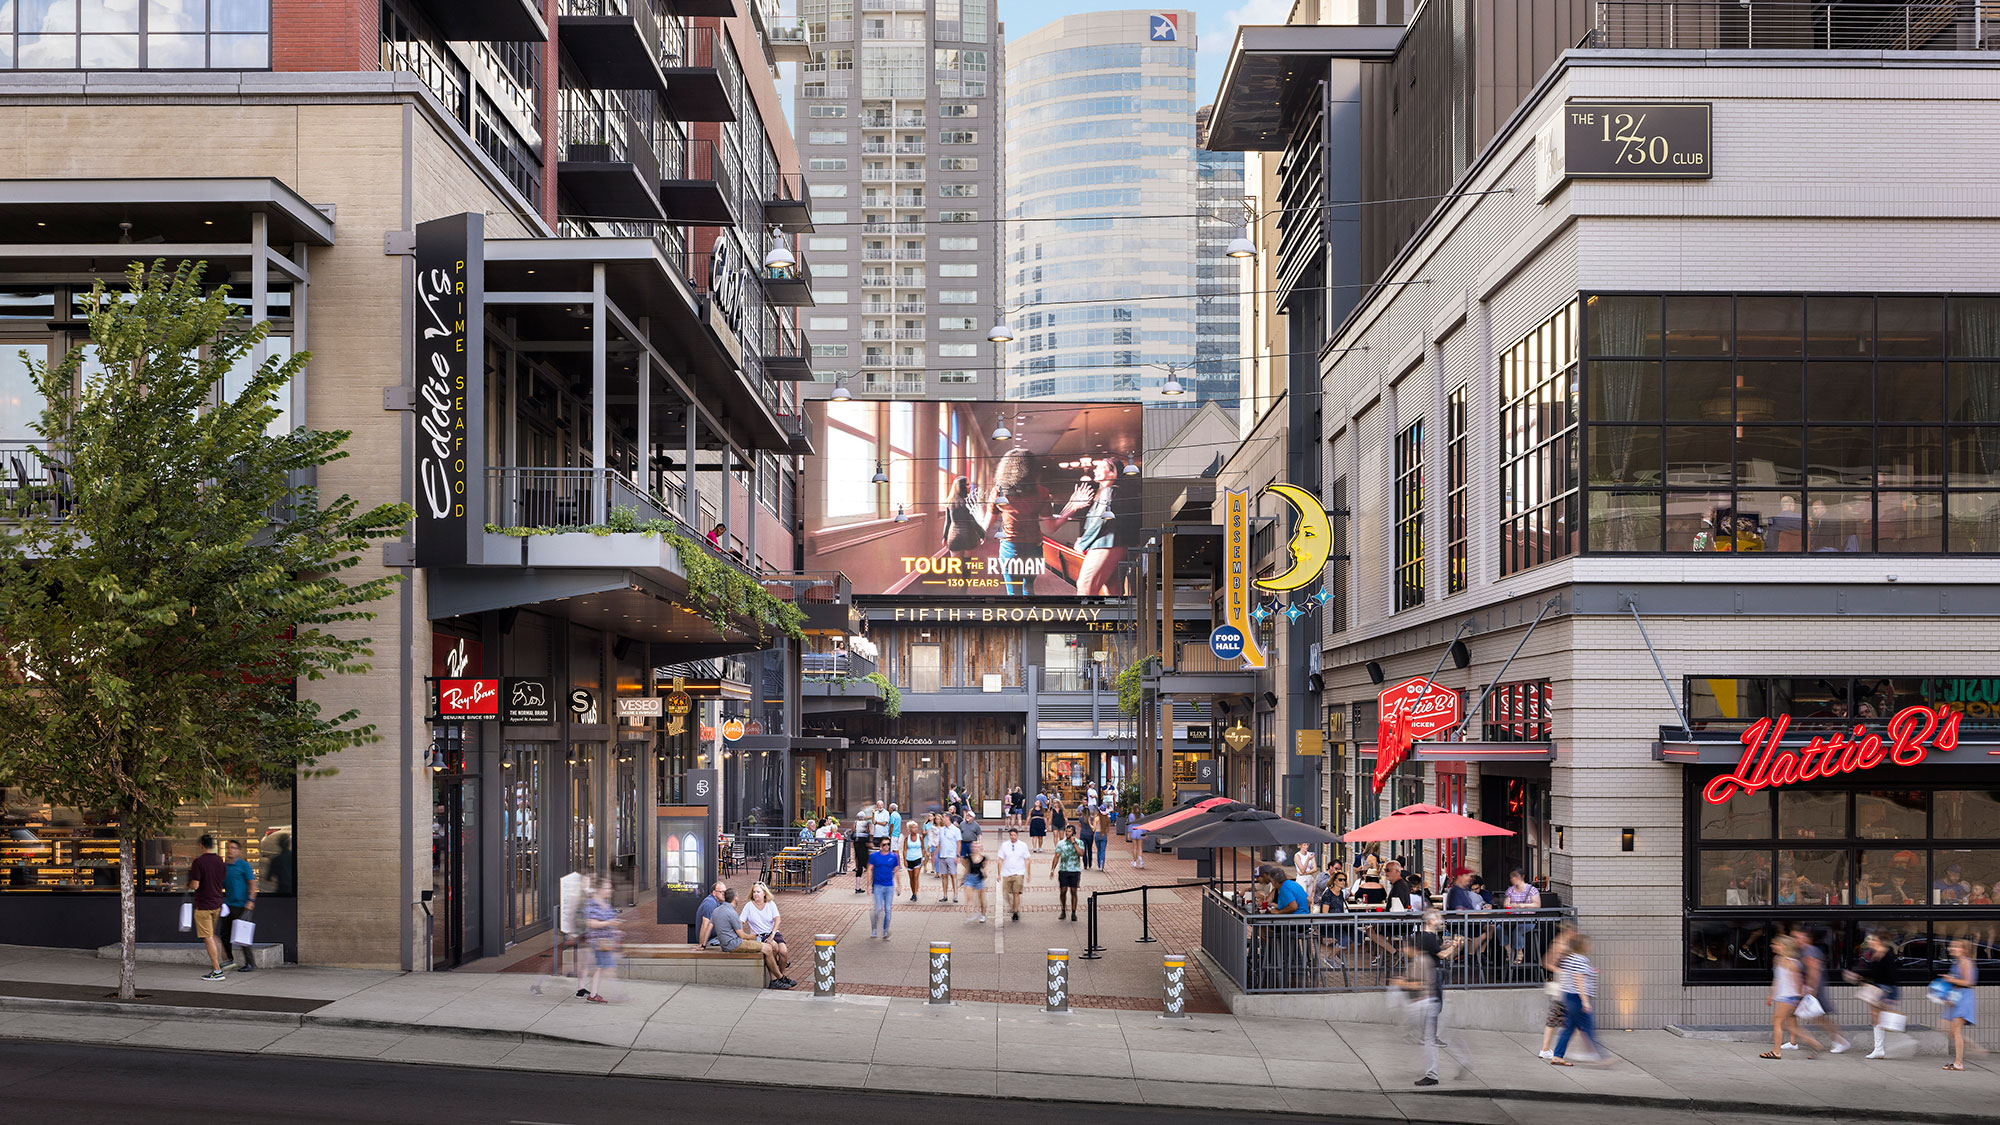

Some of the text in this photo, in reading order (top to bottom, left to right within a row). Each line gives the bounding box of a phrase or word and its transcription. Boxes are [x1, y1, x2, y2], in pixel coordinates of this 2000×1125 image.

[1571, 113, 1594, 125] THE
[1672, 152, 1703, 165] CLUB
[455, 260, 464, 353] PRIME
[418, 269, 451, 519] Eddie V's
[455, 376, 464, 518] SEAFOOD
[900, 556, 1046, 575] TOUR THE RYMAN
[1233, 500, 1241, 620] ASSEMBLY
[948, 579, 999, 587] 130 YEARS
[895, 608, 960, 621] FIFTH
[982, 608, 1101, 621] BROADWAY
[1086, 622, 1114, 631] THE
[1215, 634, 1240, 642] FOOD
[1215, 642, 1240, 650] HALL
[619, 699, 659, 711] VESEO
[899, 736, 933, 744] Access
[1703, 704, 1963, 804] Hattie B's
[818, 946, 836, 961] lyft
[931, 953, 948, 968] lyft
[818, 961, 836, 976] lyft
[931, 968, 948, 984] lyft
[1048, 961, 1065, 976] lyft
[1167, 967, 1184, 982] lyft
[818, 976, 836, 991] lyft
[1048, 976, 1065, 991] lyft
[1167, 982, 1184, 997] lyft
[931, 984, 948, 999] lyft
[1048, 991, 1065, 1006] lyft
[1167, 998, 1184, 1012] lyft
